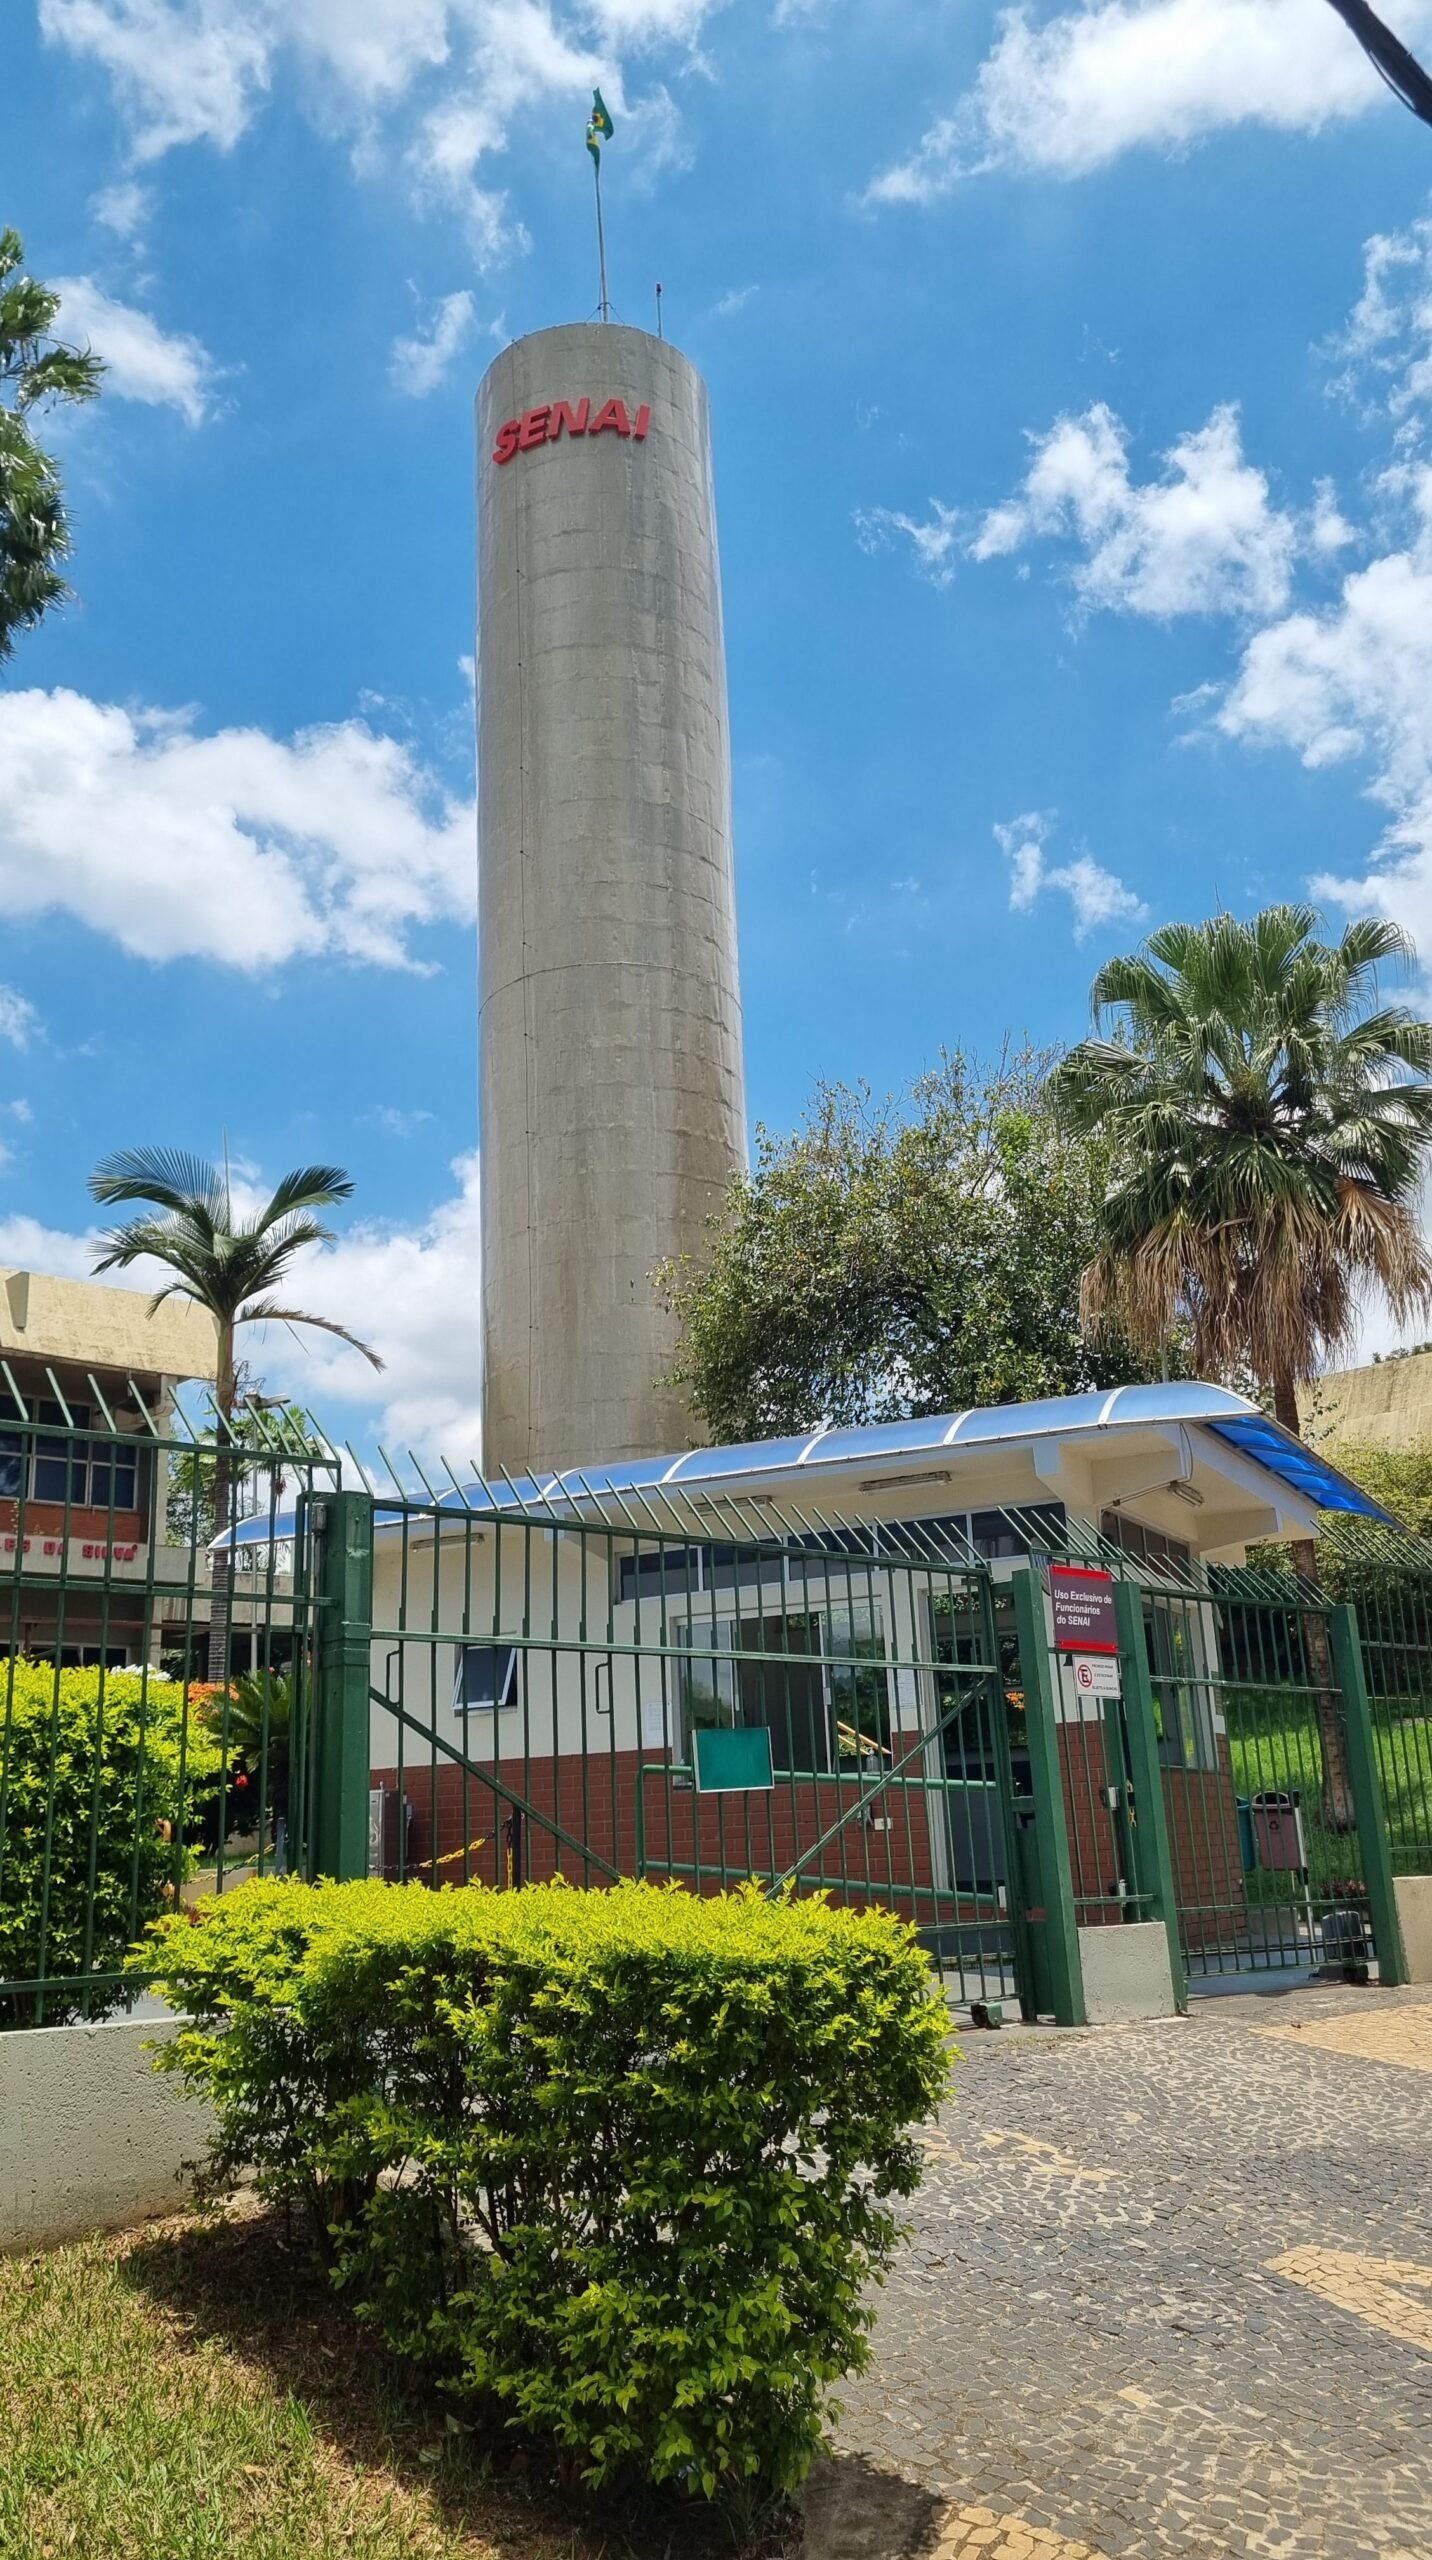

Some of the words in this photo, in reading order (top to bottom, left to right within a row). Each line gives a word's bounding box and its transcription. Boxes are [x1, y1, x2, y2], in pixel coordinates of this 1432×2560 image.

[492, 396, 651, 465] SENAI
[1054, 1589, 1069, 1600] Uso
[1070, 1591, 1103, 1603] Exclusivo
[1103, 1593, 1112, 1604] de
[1055, 1602, 1101, 1614] Funcionários
[1056, 1614, 1066, 1624] do
[1067, 1616, 1090, 1626] SENAI
